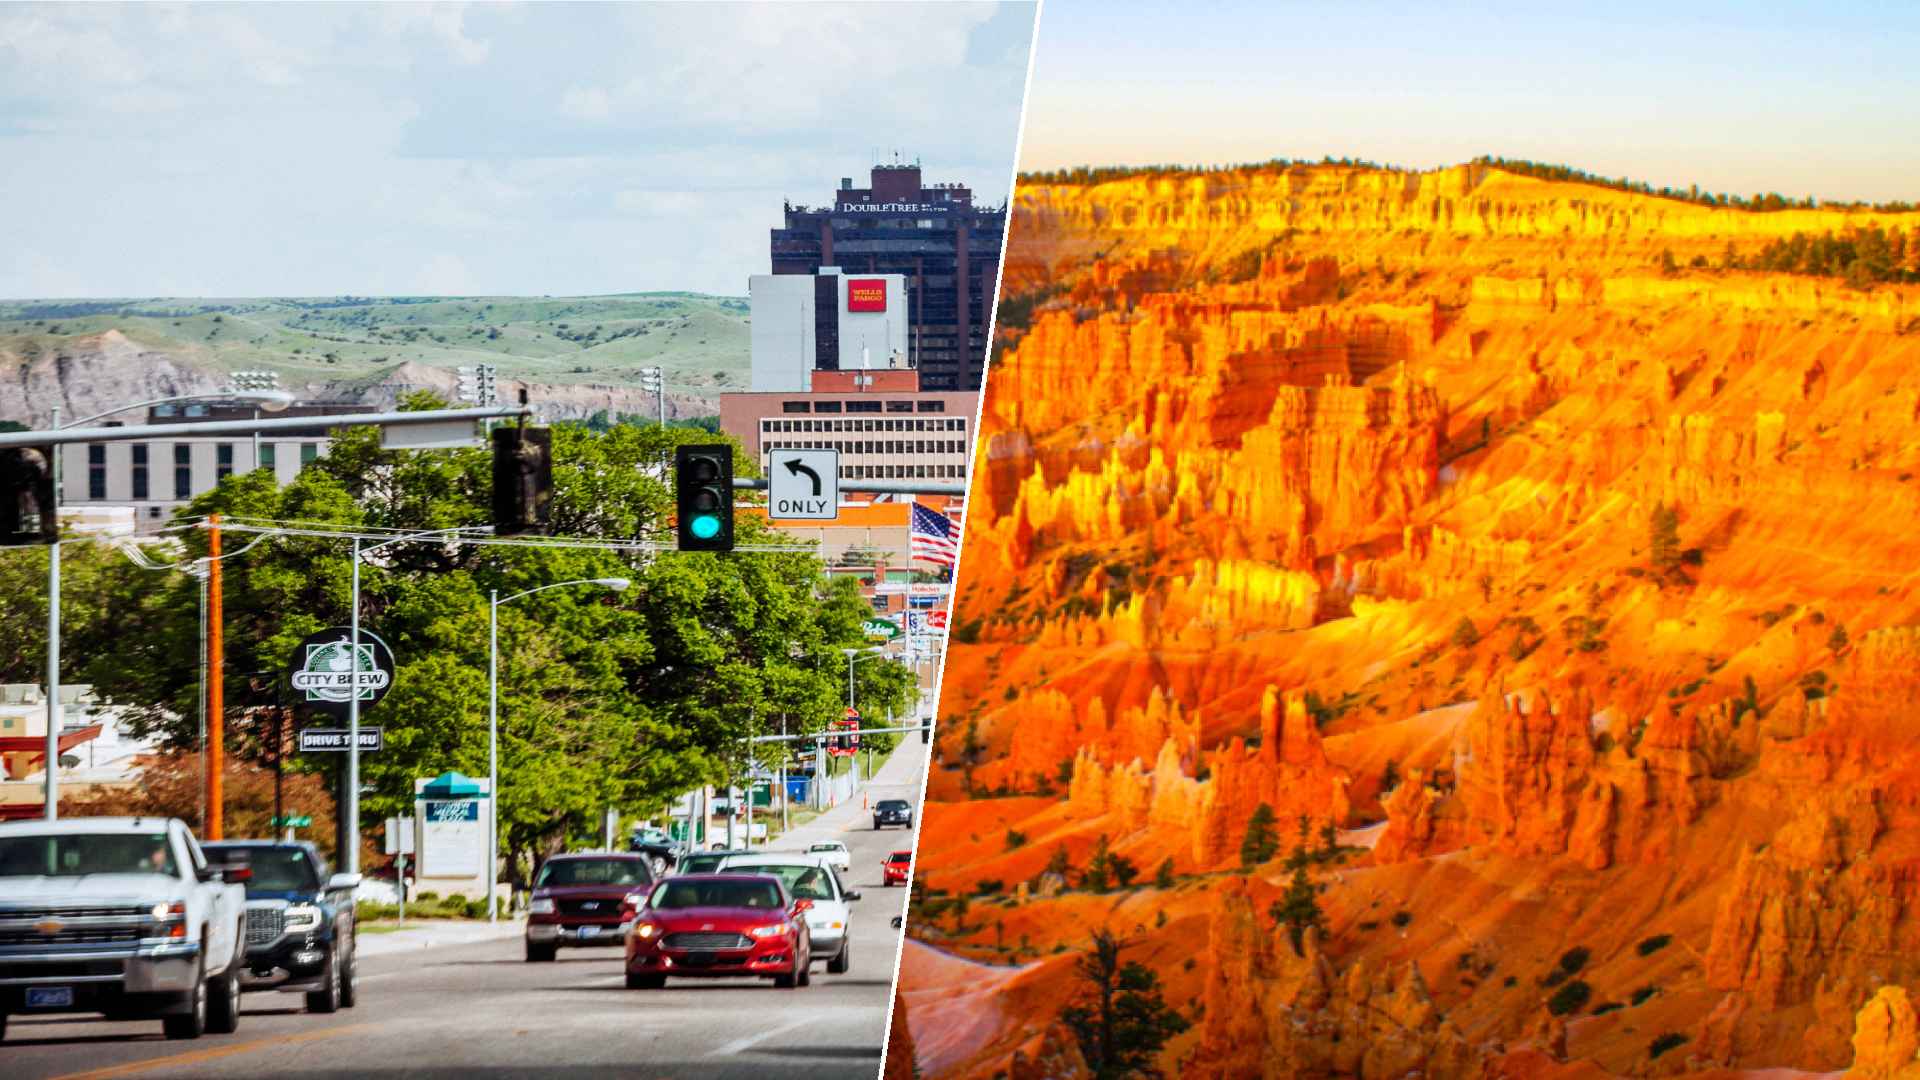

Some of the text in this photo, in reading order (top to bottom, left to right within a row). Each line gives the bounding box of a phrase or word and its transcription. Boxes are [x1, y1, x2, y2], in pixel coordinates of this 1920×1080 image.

[778, 499, 828, 513] ONLY
[297, 674, 332, 685] CITY
[303, 735, 377, 746] DRIVE TRU
